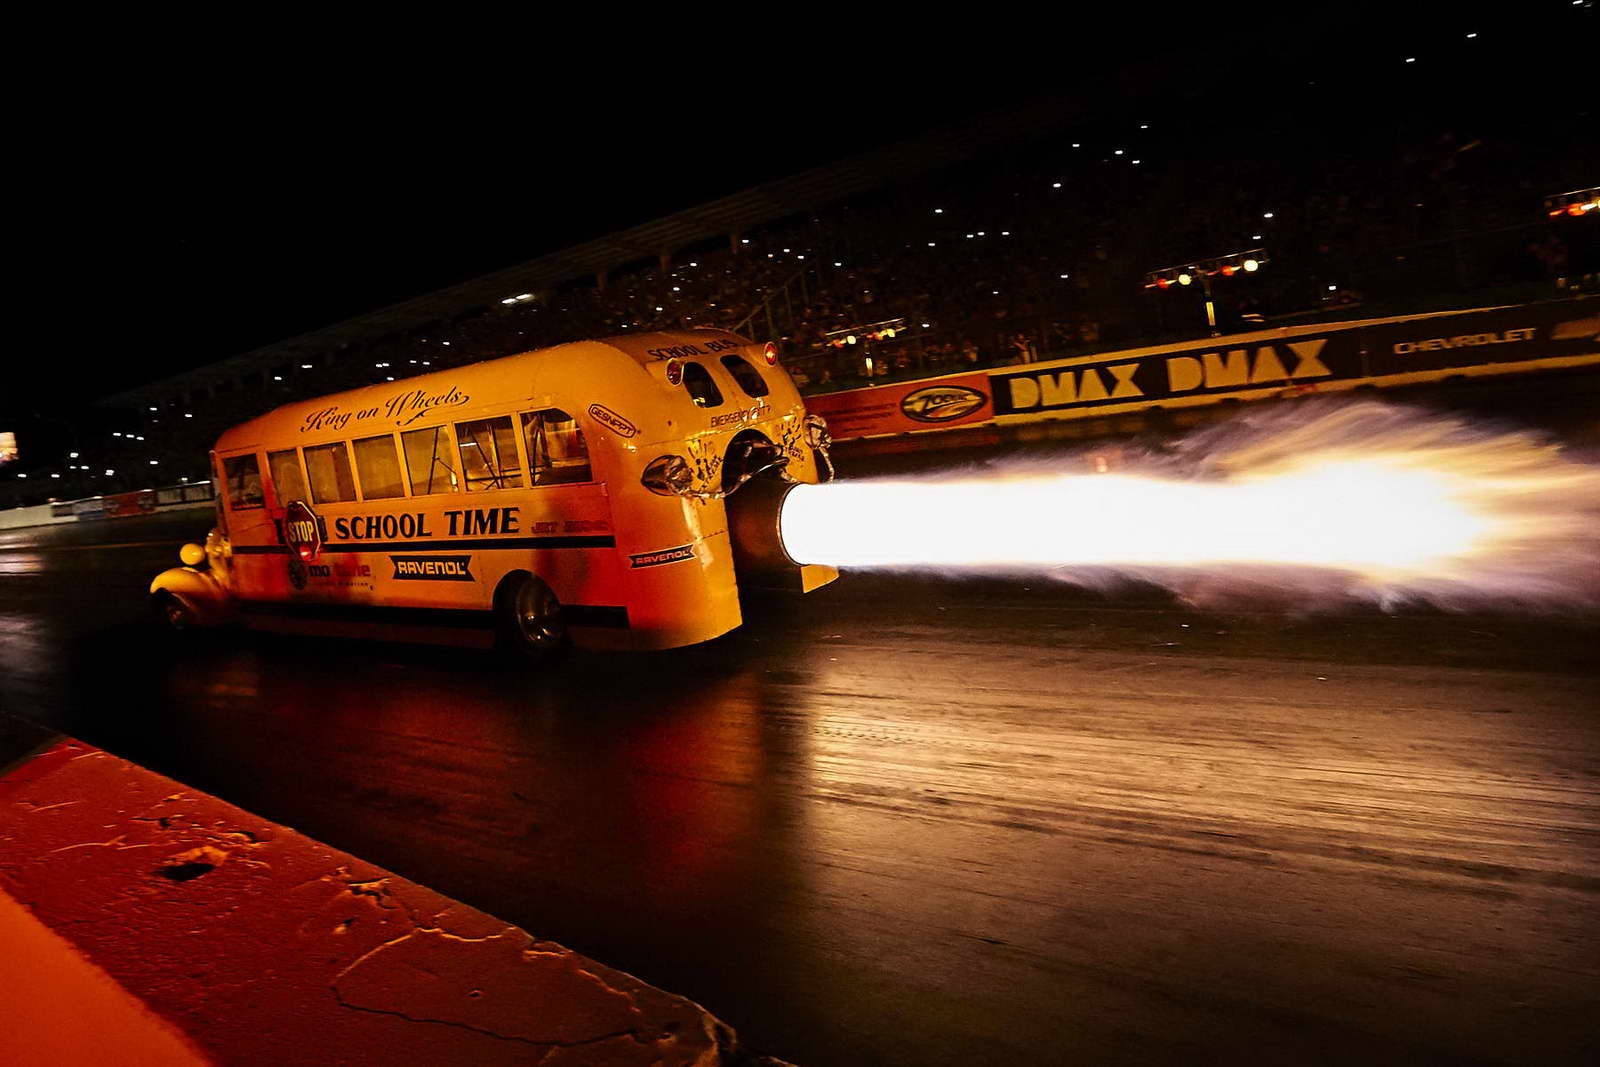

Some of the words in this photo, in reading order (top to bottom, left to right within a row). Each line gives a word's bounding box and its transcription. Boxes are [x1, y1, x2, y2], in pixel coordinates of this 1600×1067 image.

[647, 344, 708, 360] SCHOOL
[704, 338, 737, 352] BUS
[1393, 327, 1537, 355] CHEVROLET
[1008, 363, 1143, 410] DMAX
[1167, 340, 1332, 393] DMAX
[300, 407, 353, 432] King
[357, 405, 379, 420] on
[385, 386, 471, 426] Wheels
[288, 520, 314, 543] STOP
[335, 512, 432, 540] SCHOOL
[444, 507, 520, 536] TIME
[398, 561, 465, 576] RAVENOL
[636, 549, 689, 566] RAVENOL
